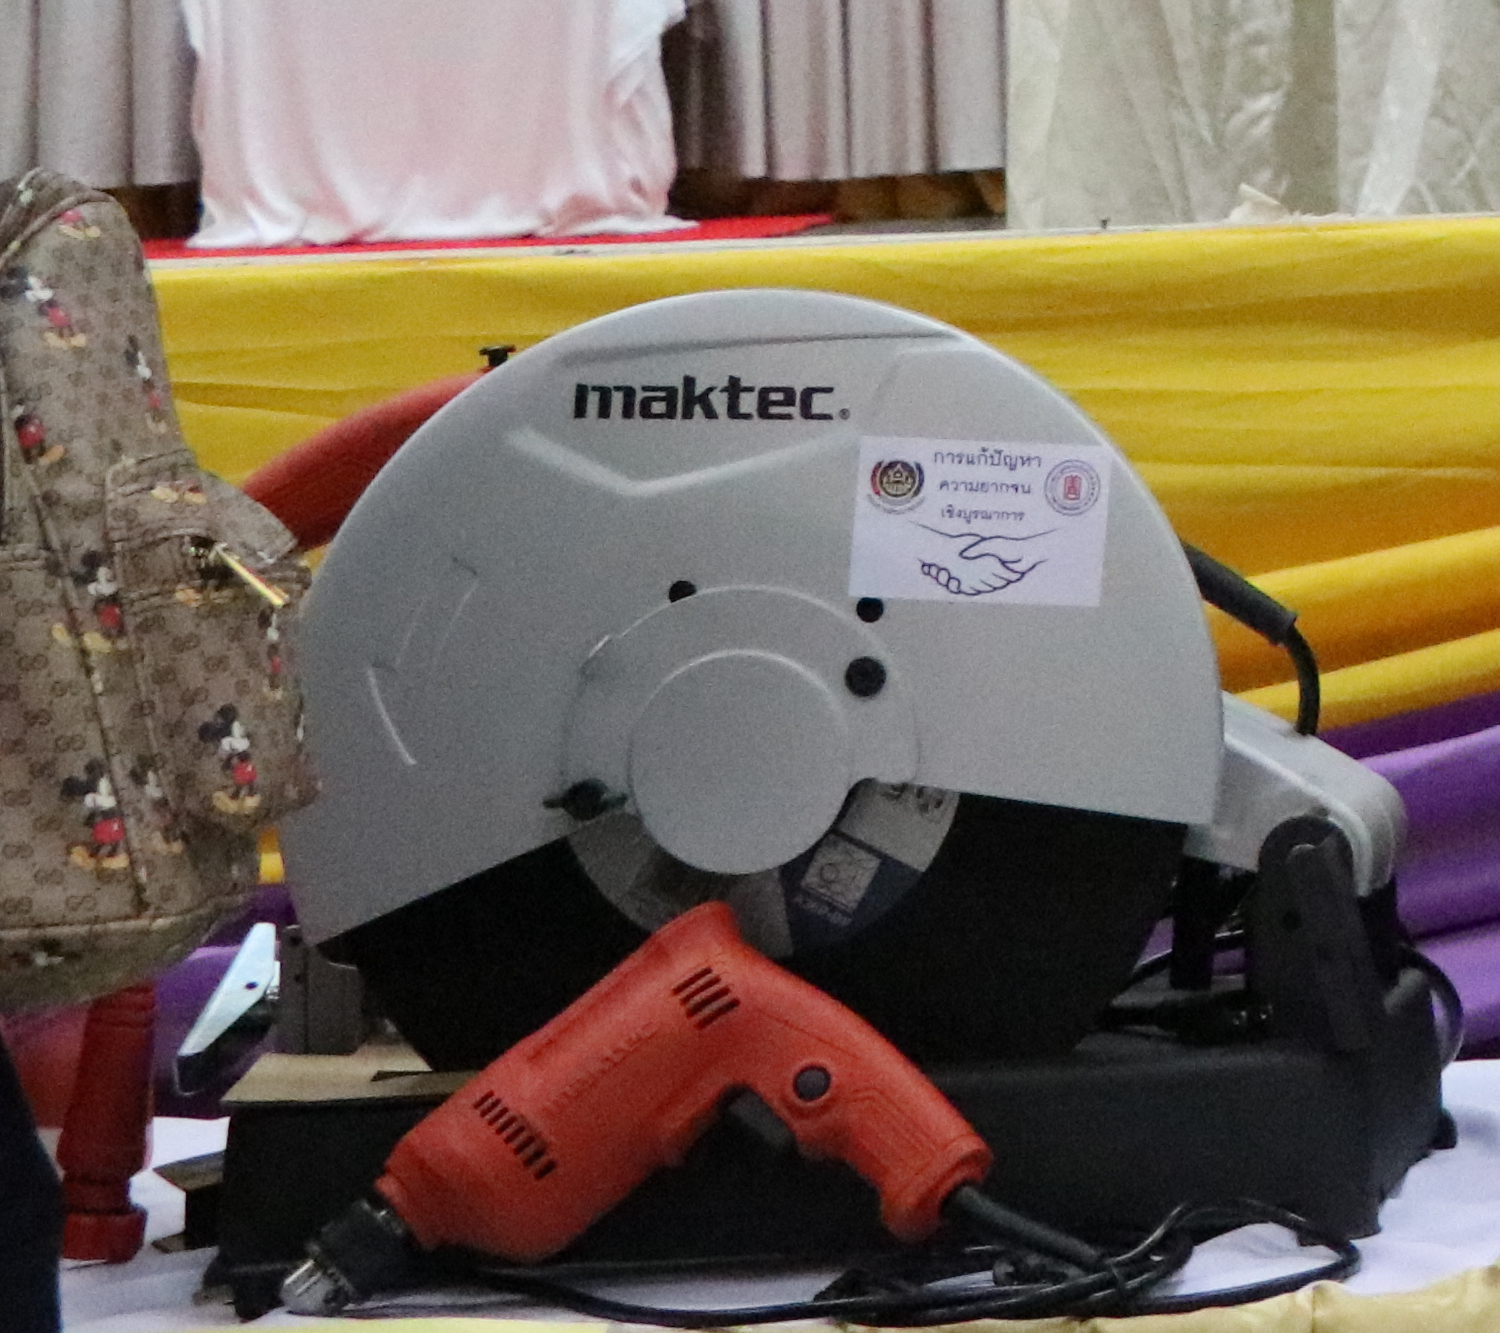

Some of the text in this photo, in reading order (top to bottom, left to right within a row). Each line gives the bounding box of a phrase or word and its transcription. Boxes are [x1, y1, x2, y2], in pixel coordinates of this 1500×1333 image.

[572, 374, 835, 421] maktec
[933, 446, 1042, 471] การแก้ปัญหา
